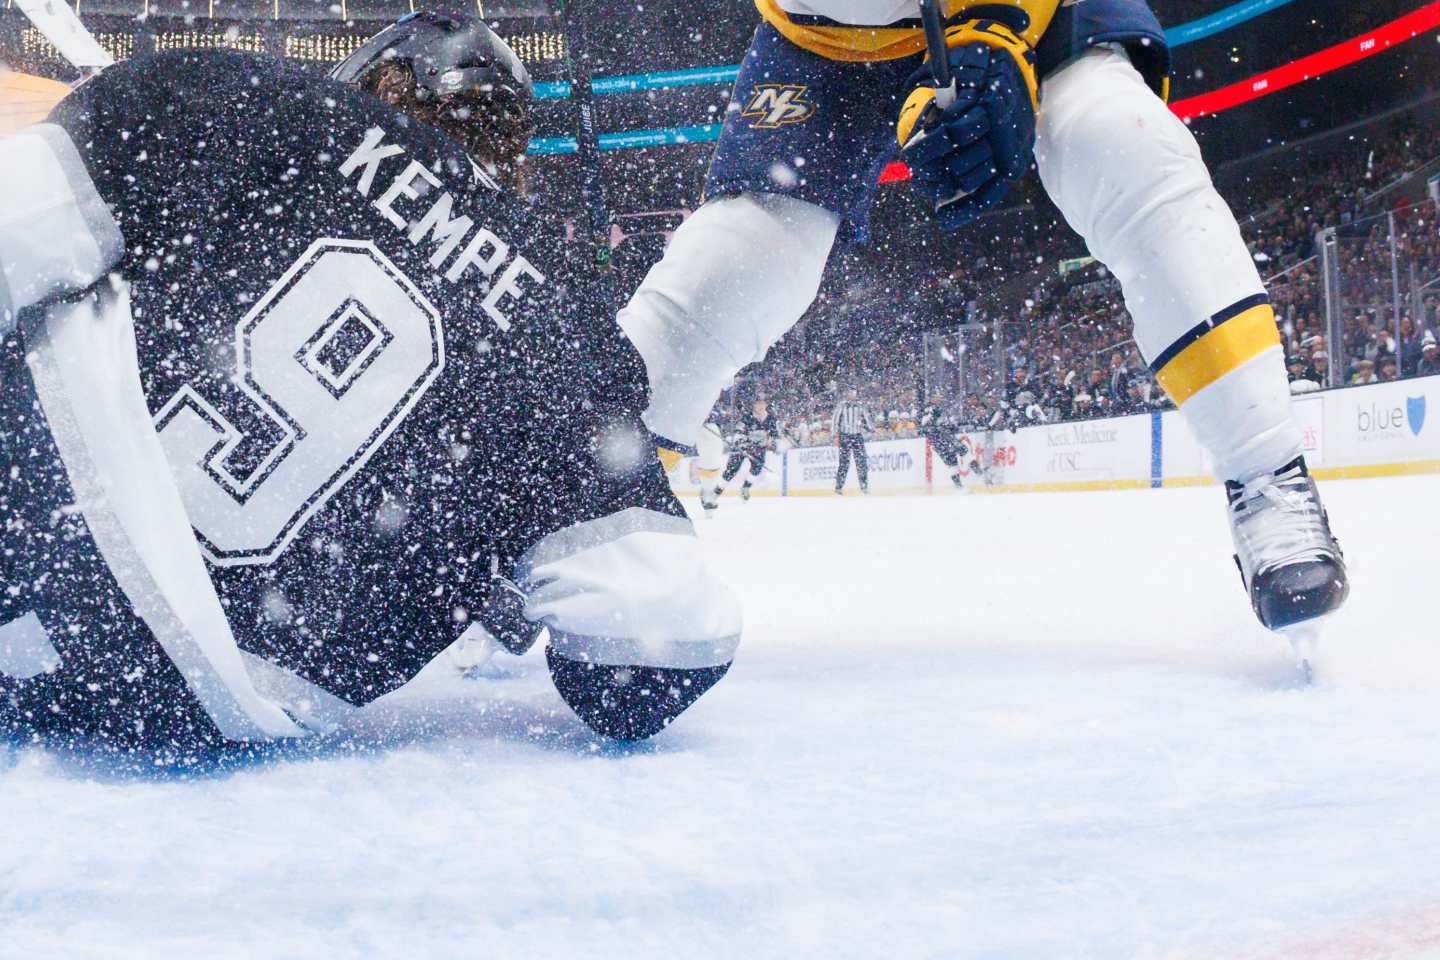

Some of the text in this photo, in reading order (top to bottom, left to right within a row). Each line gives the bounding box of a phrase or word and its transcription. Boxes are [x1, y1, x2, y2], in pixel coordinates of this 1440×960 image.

[1360, 38, 1375, 51] FAN
[1253, 79, 1268, 91] FAN
[339, 126, 545, 332] KEMPE
[154, 237, 445, 567] 9
[1357, 403, 1404, 432] blue
[866, 451, 913, 473] pectrum
